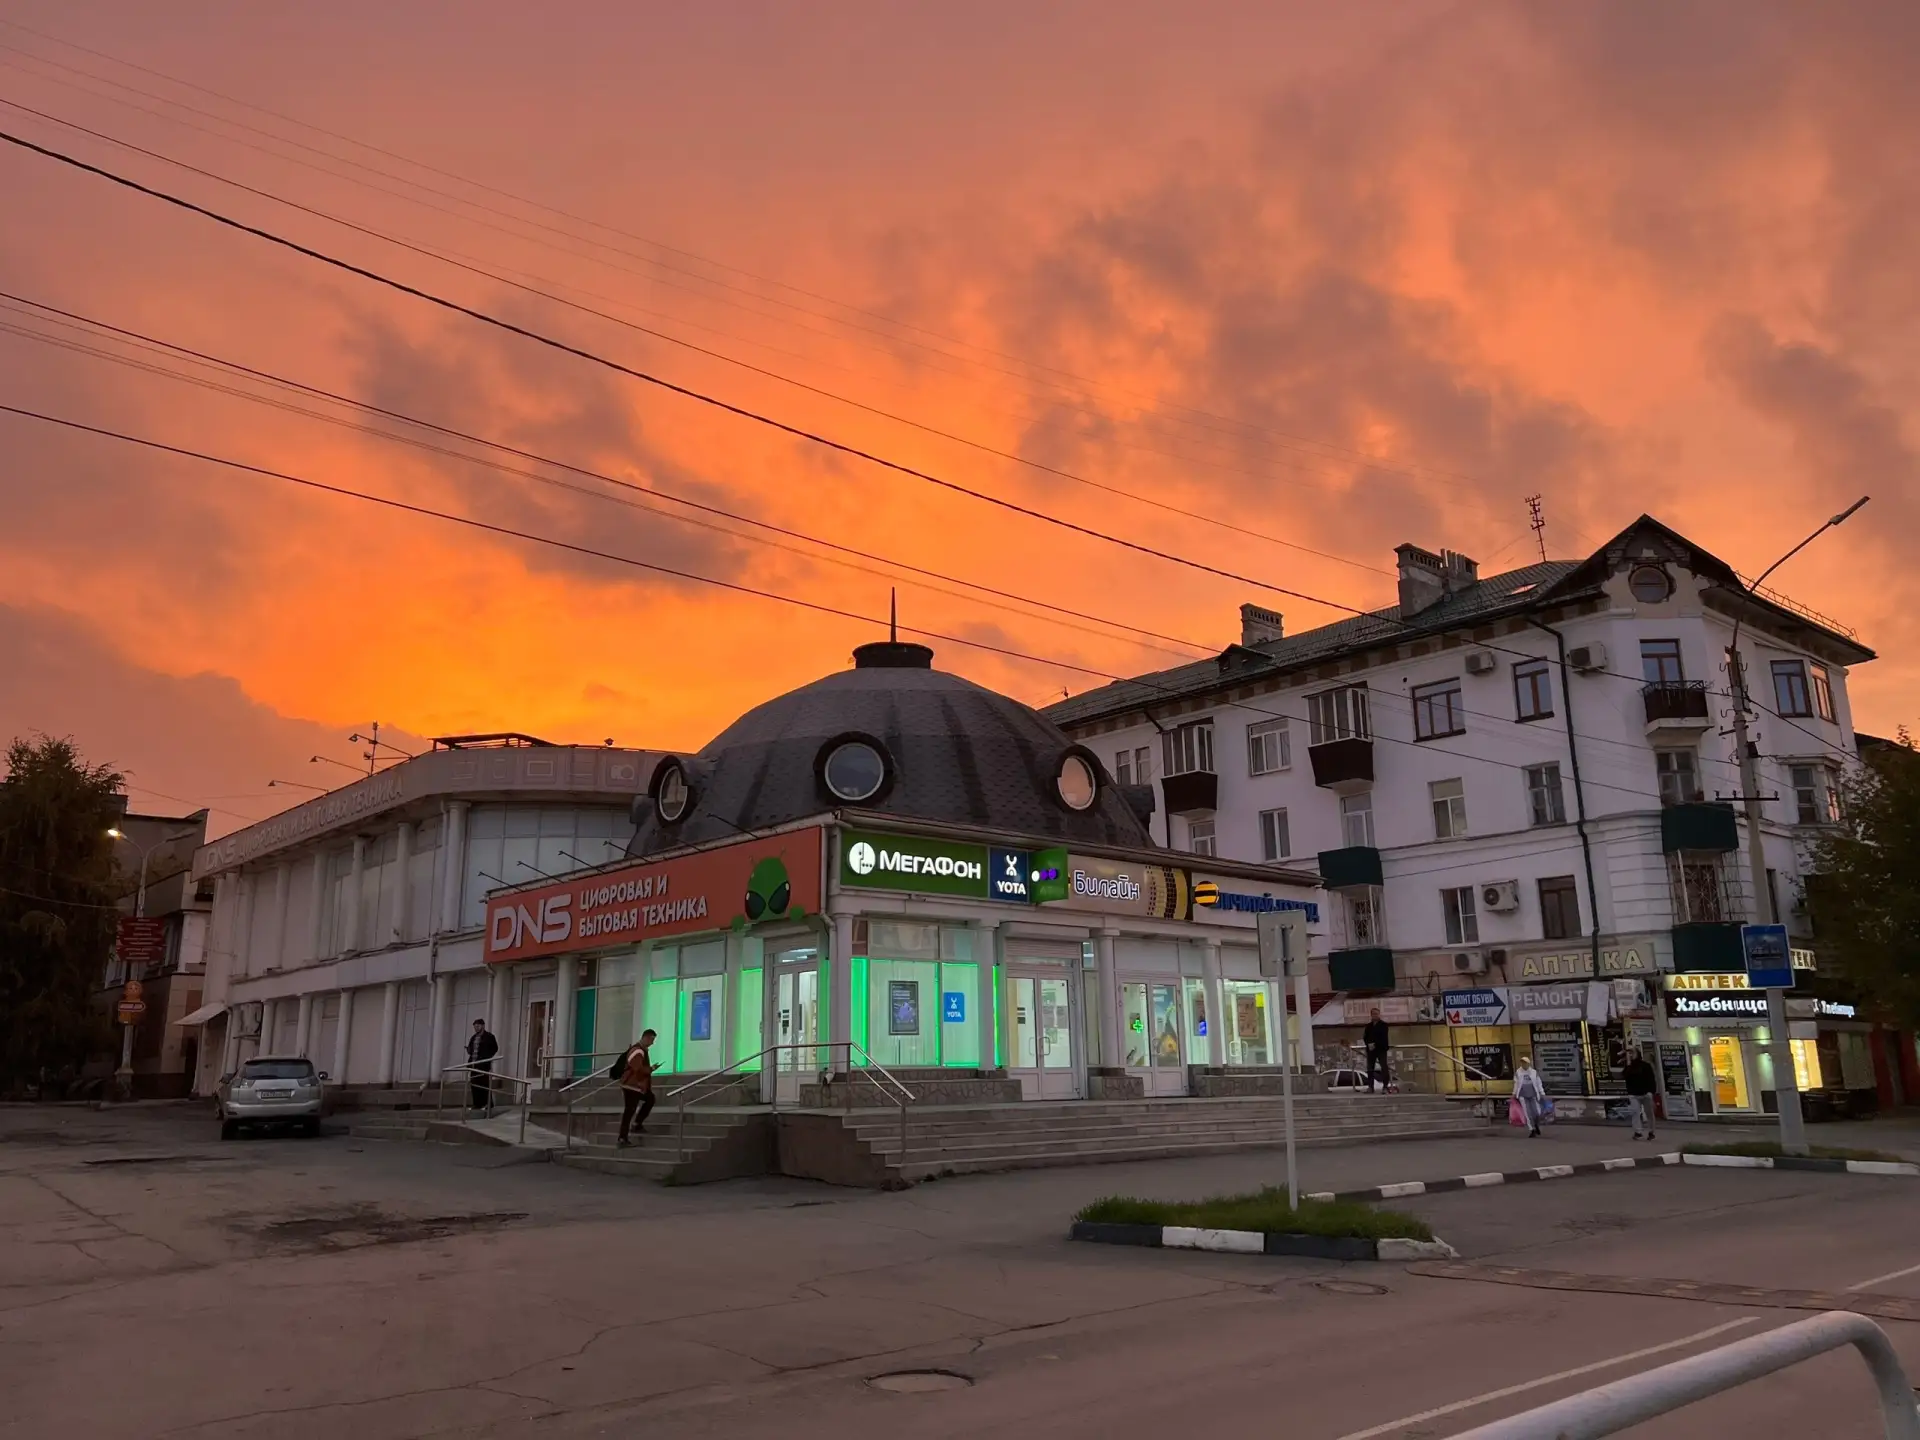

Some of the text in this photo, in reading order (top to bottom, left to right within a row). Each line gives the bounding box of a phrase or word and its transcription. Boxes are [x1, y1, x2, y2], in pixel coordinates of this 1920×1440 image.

[579, 874, 668, 911] ЦИФРОВАЯ И
[997, 880, 1027, 896] YOTA
[491, 894, 572, 952] DNS
[578, 895, 708, 938] БЫТОВАЯ ТЕХНИКА
[1790, 951, 1817, 968] ТЕКА
[1673, 975, 1750, 989] АПТЕК
[1445, 993, 1494, 1006] РЕМОНТ ОБУВИ
[1512, 990, 1584, 1007] РЕМОНТ
[1675, 997, 1767, 1013] Хлебница
